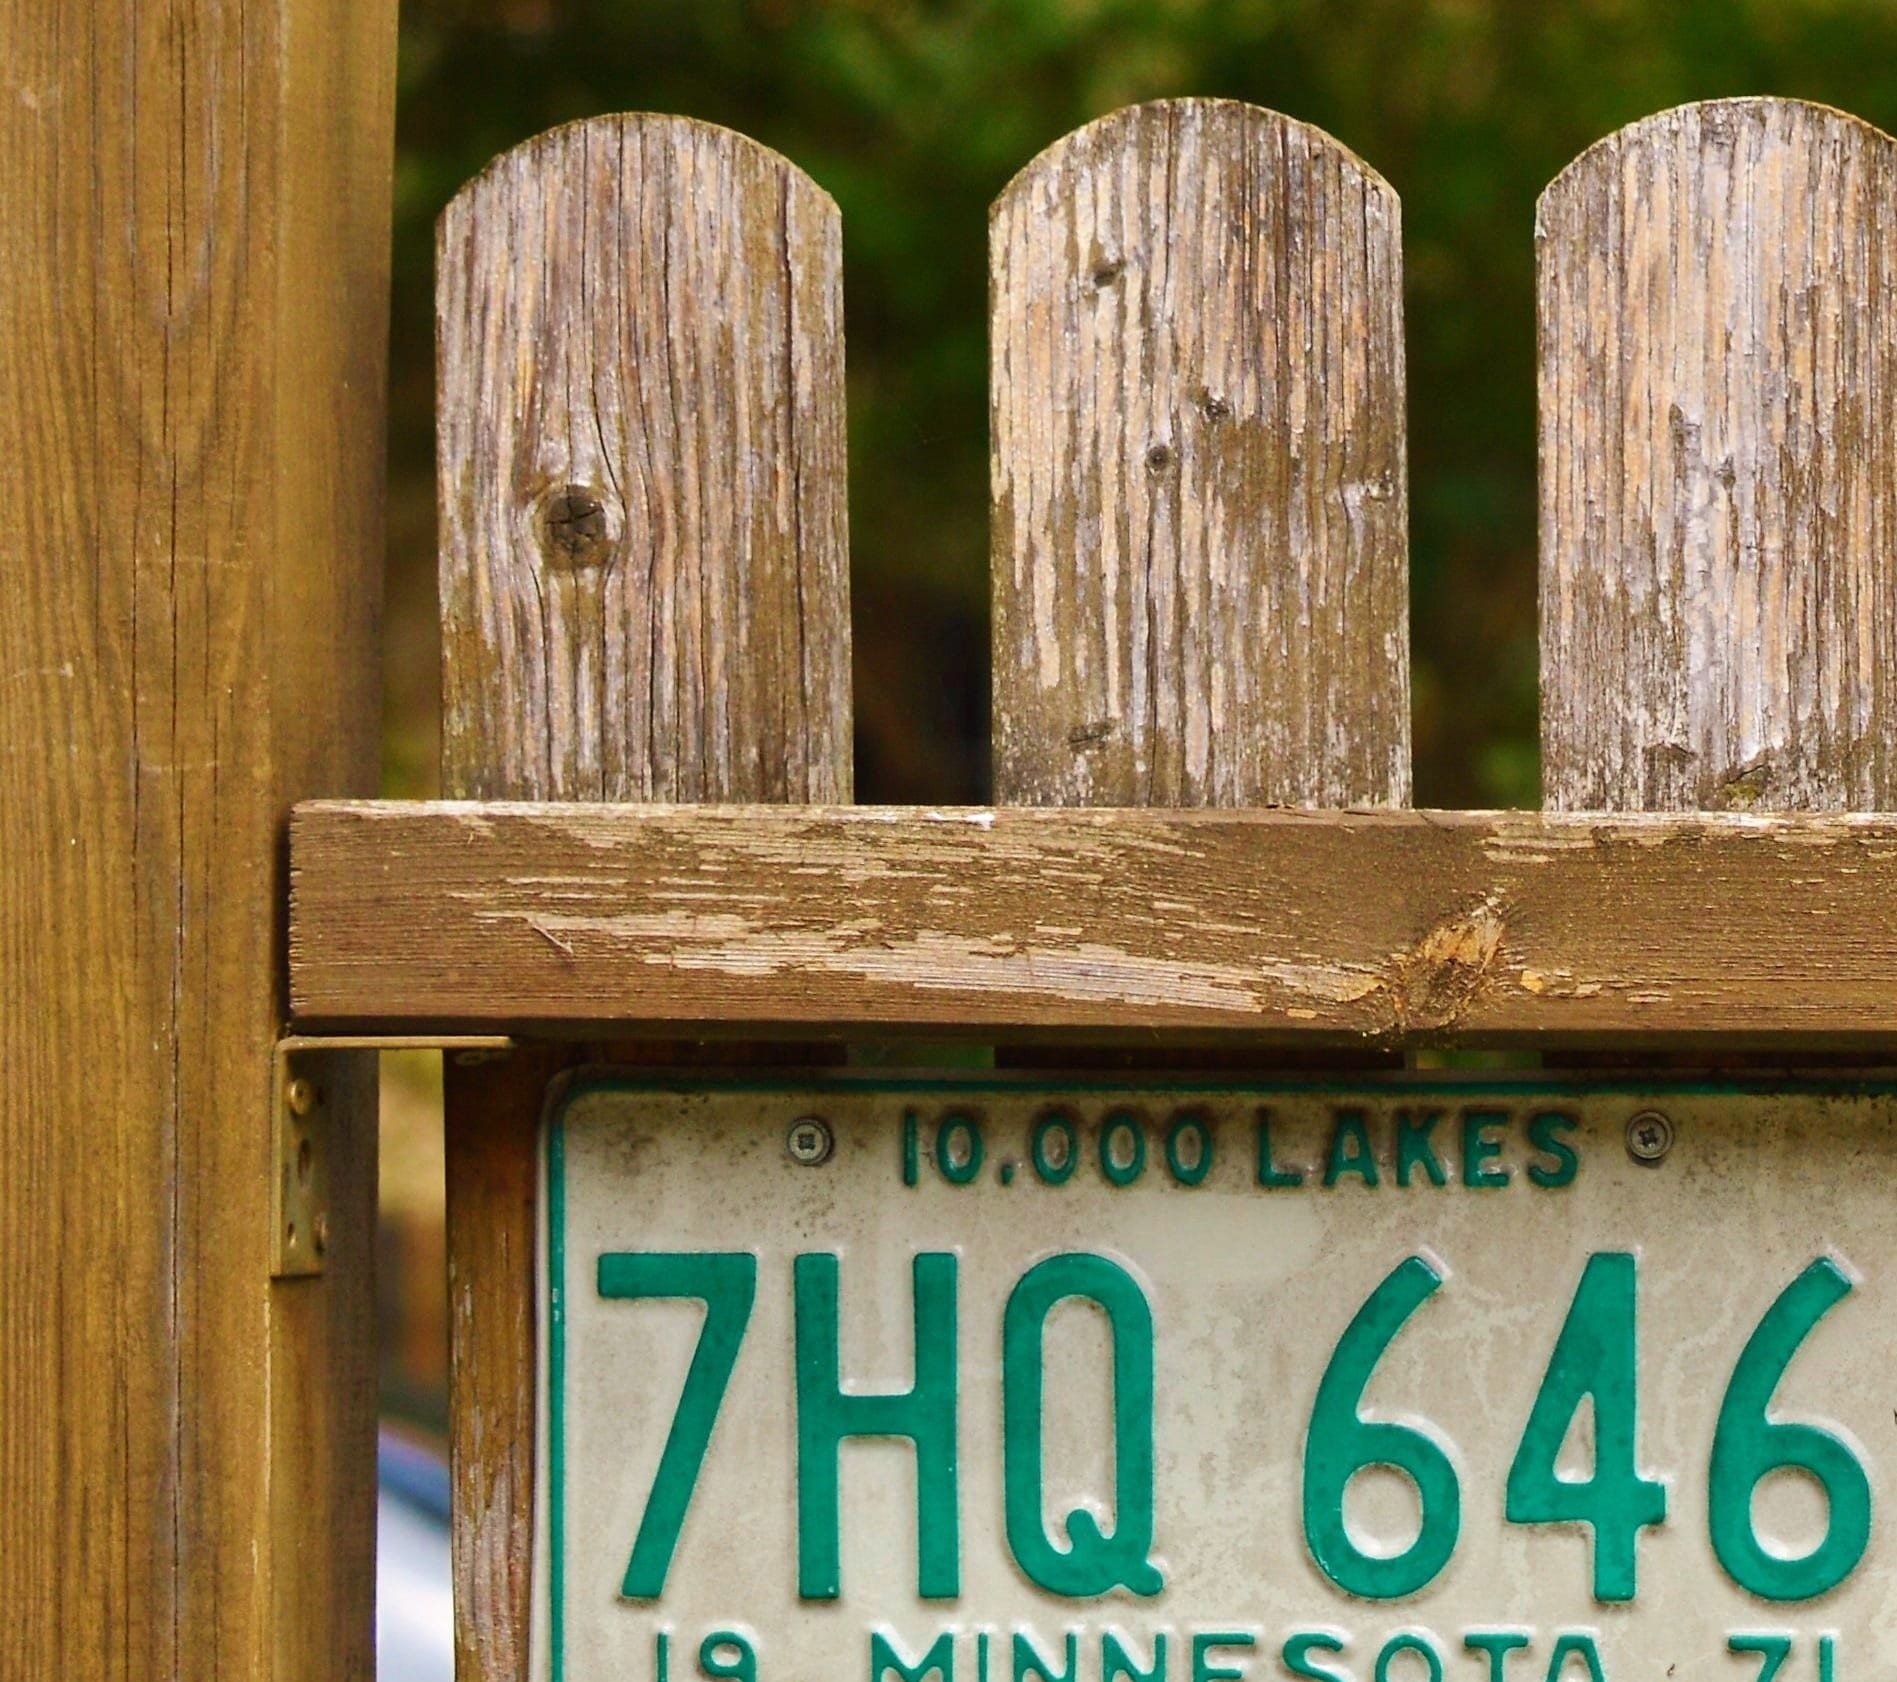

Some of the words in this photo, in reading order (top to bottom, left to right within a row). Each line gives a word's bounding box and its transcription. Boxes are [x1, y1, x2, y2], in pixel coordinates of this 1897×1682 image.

[1257, 1107, 1581, 1189] LAKES
[597, 1252, 1165, 1599] 7HQ
[1301, 1253, 1873, 1601] 646
